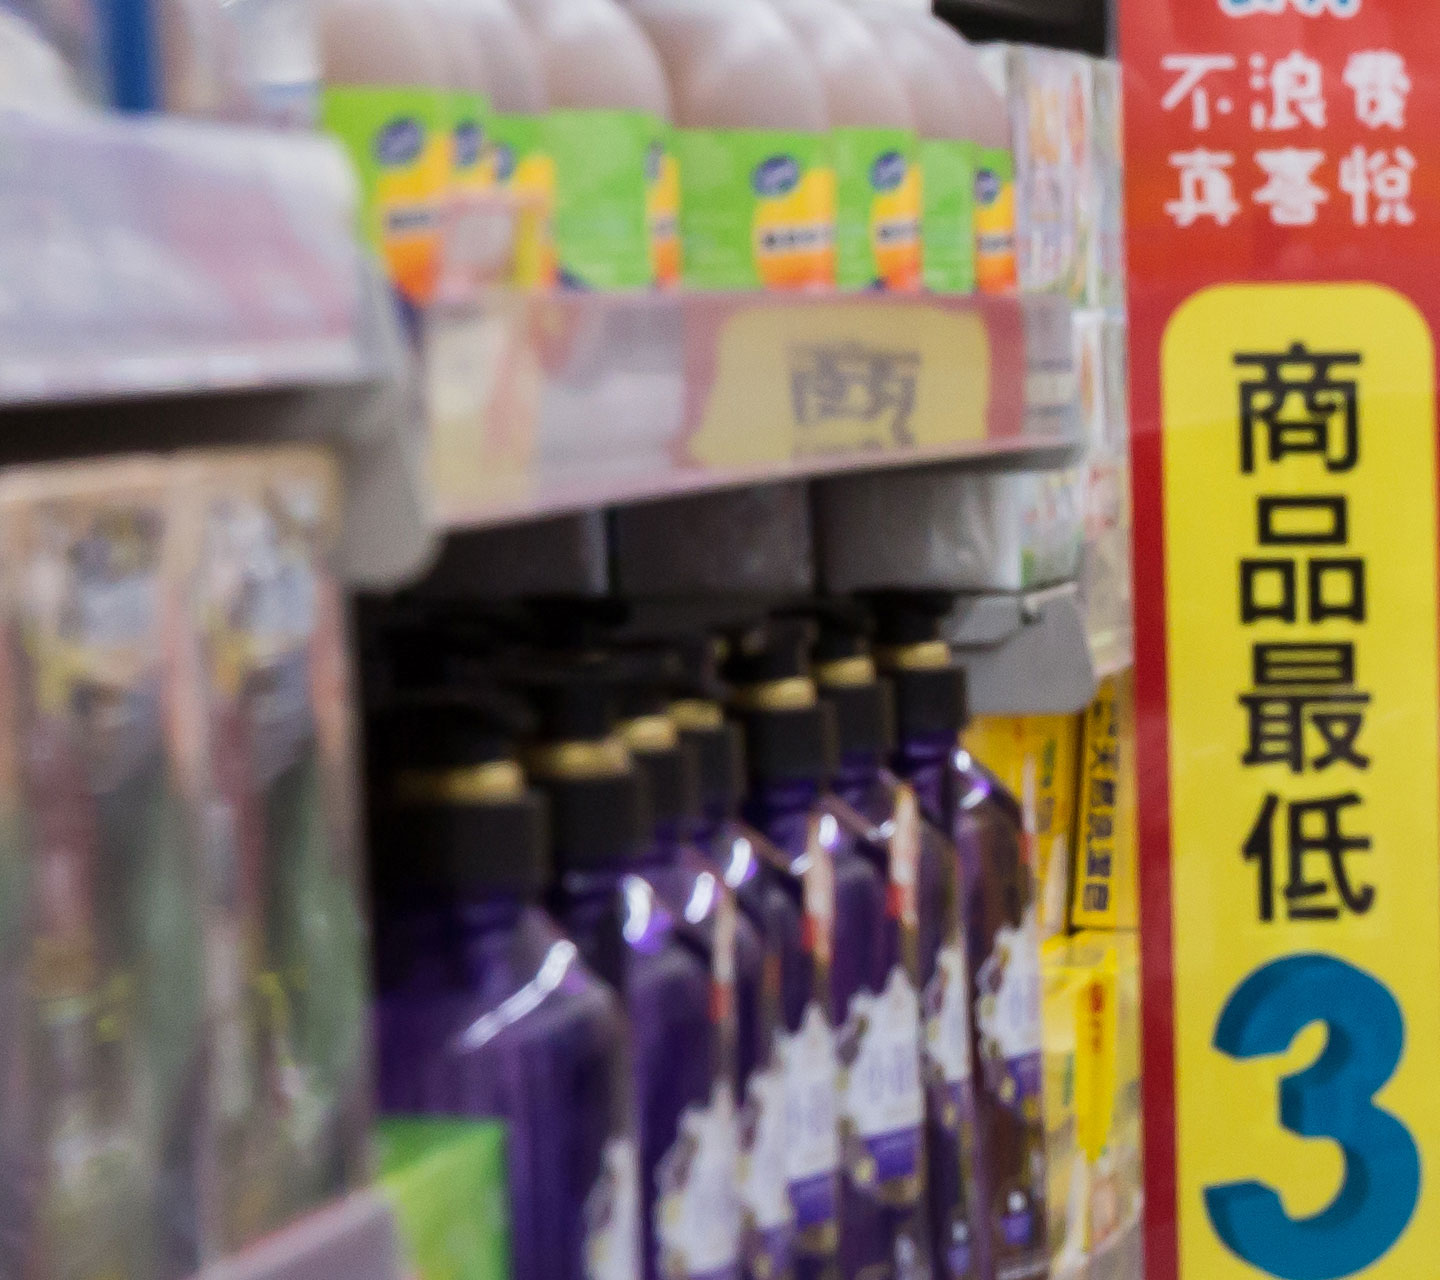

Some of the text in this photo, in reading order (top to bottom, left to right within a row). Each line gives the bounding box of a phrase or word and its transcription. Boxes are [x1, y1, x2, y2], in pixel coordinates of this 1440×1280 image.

[1160, 48, 1414, 132] 不浪費
[1163, 145, 1418, 228] 真喜悅
[1234, 342, 1375, 923] 商品最低
